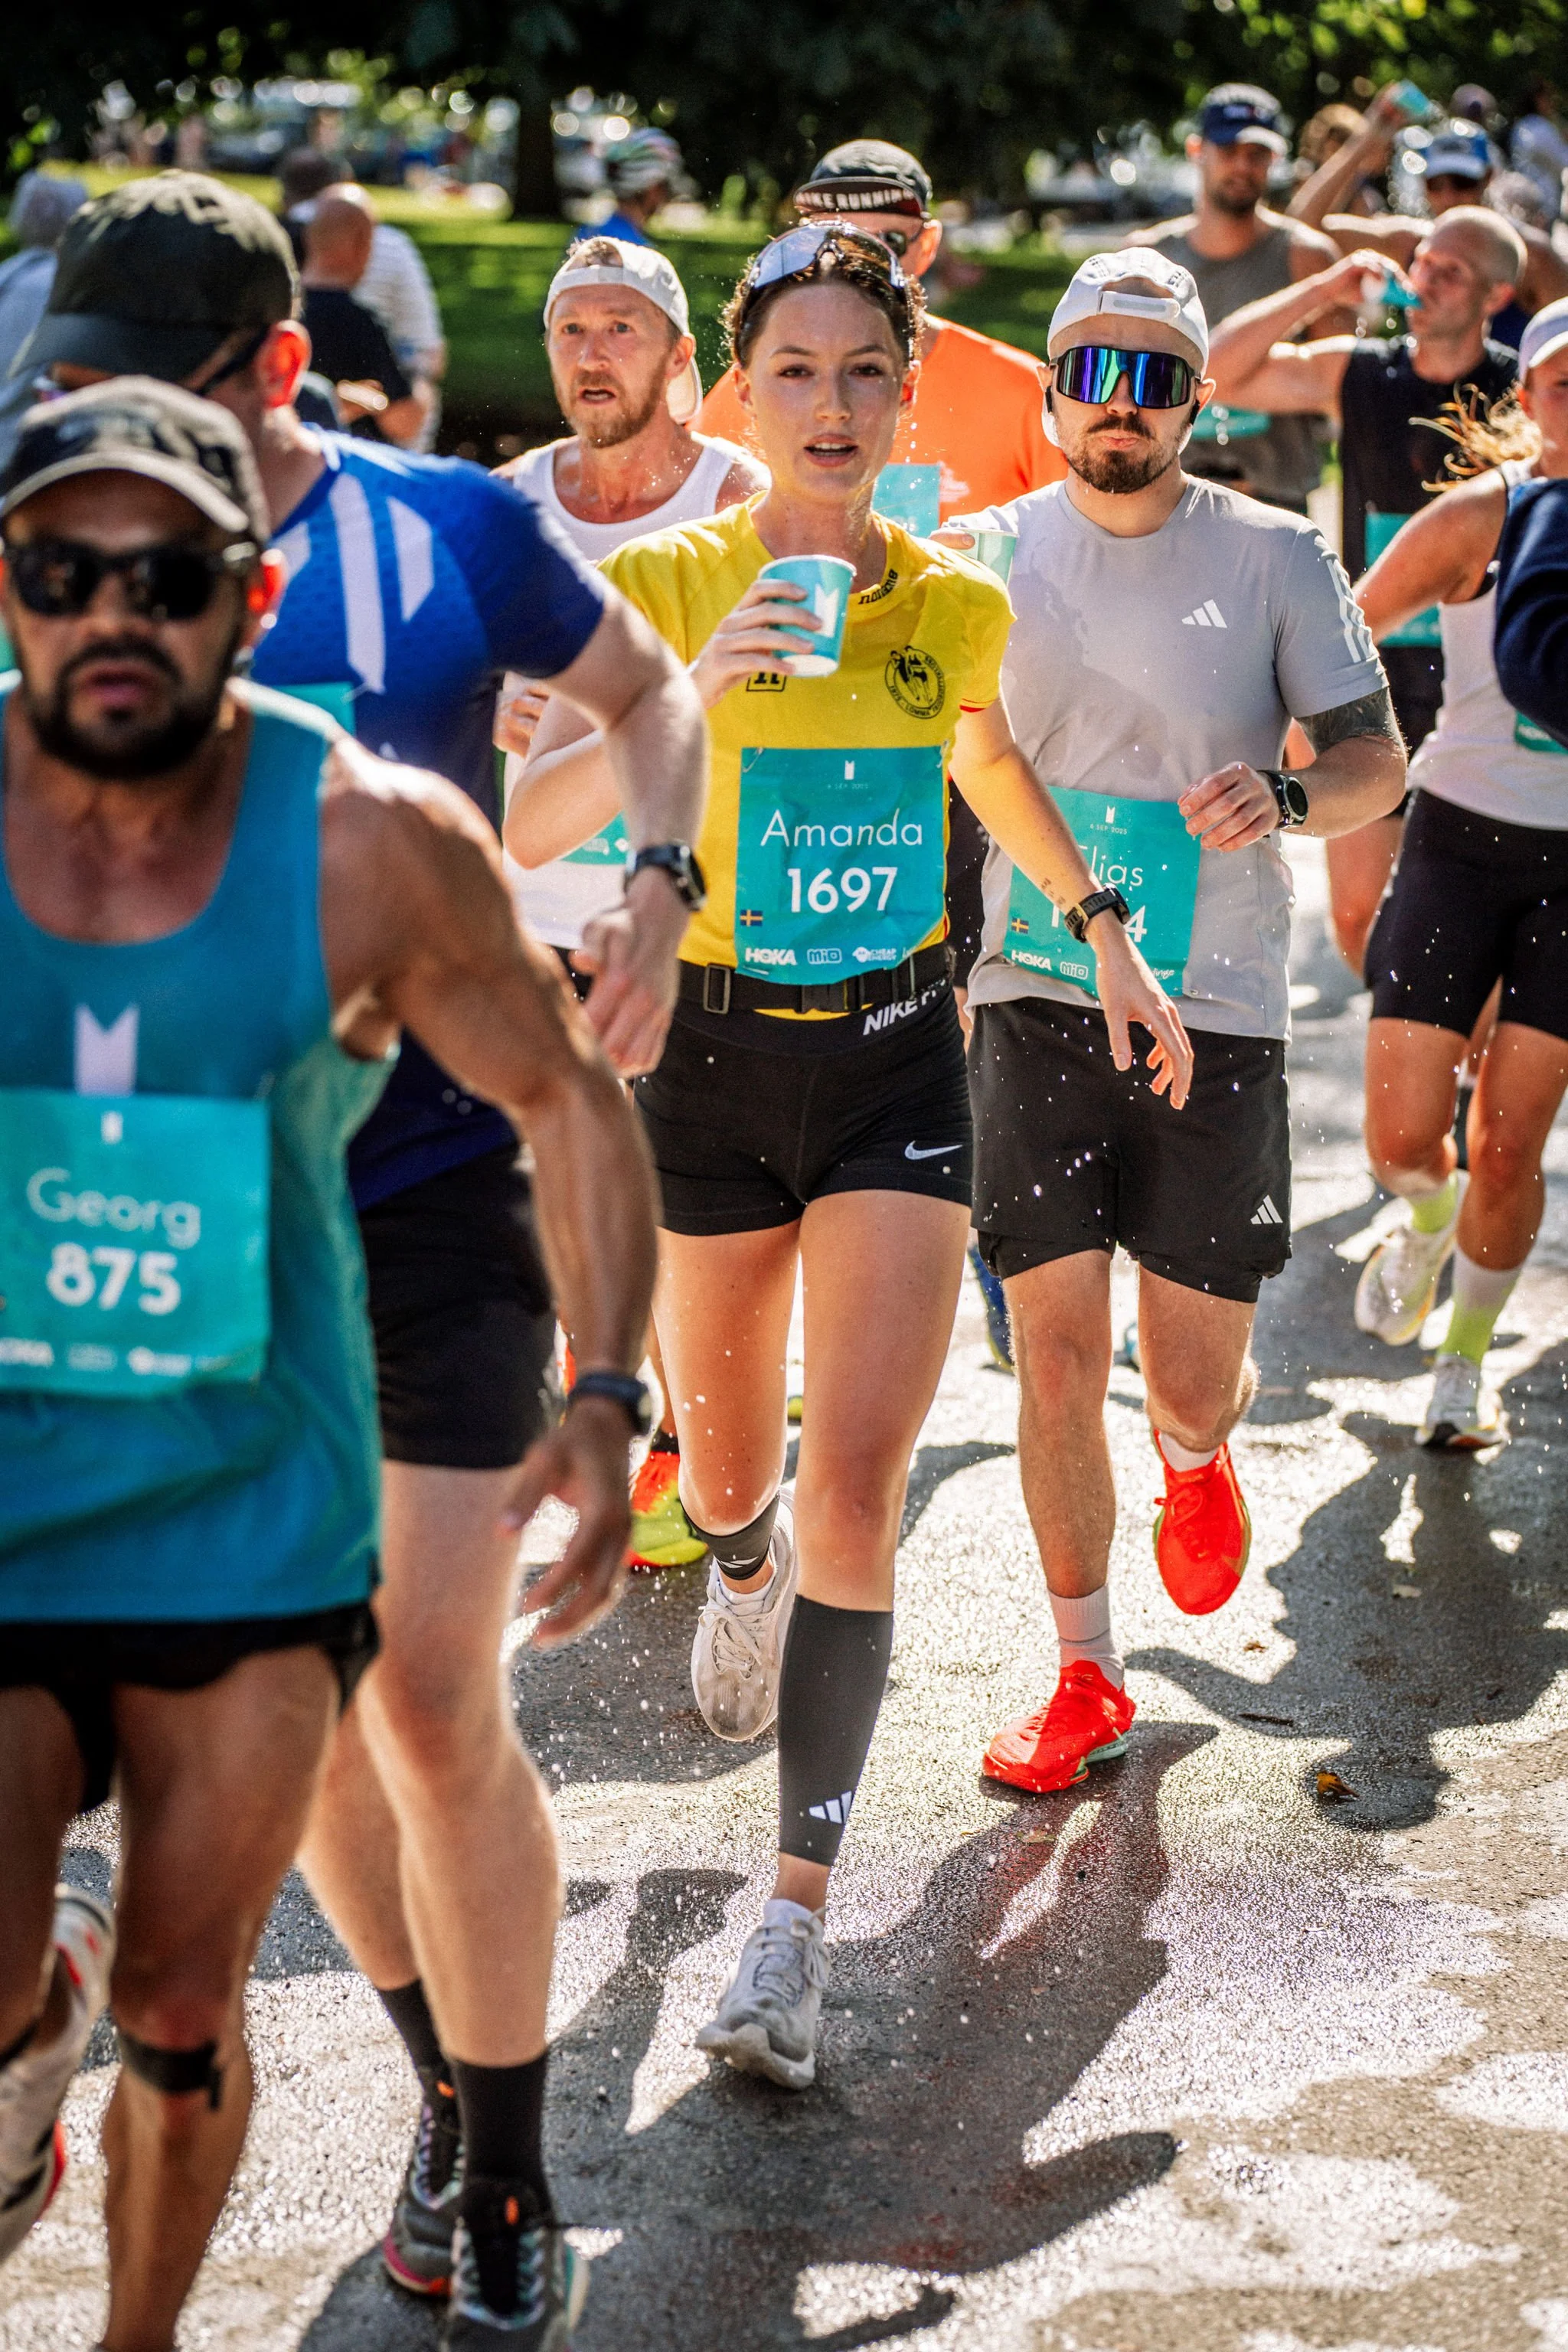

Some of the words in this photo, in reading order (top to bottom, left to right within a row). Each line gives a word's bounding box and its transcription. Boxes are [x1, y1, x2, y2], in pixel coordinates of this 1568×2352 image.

[760, 808, 922, 847] Amanda
[787, 867, 897, 913] 1697
[745, 948, 797, 965] HOKA
[1011, 949, 1052, 971] HOKA
[863, 998, 917, 1035] NIKE
[26, 1167, 201, 1250] Georg
[46, 1241, 181, 1315] 875
